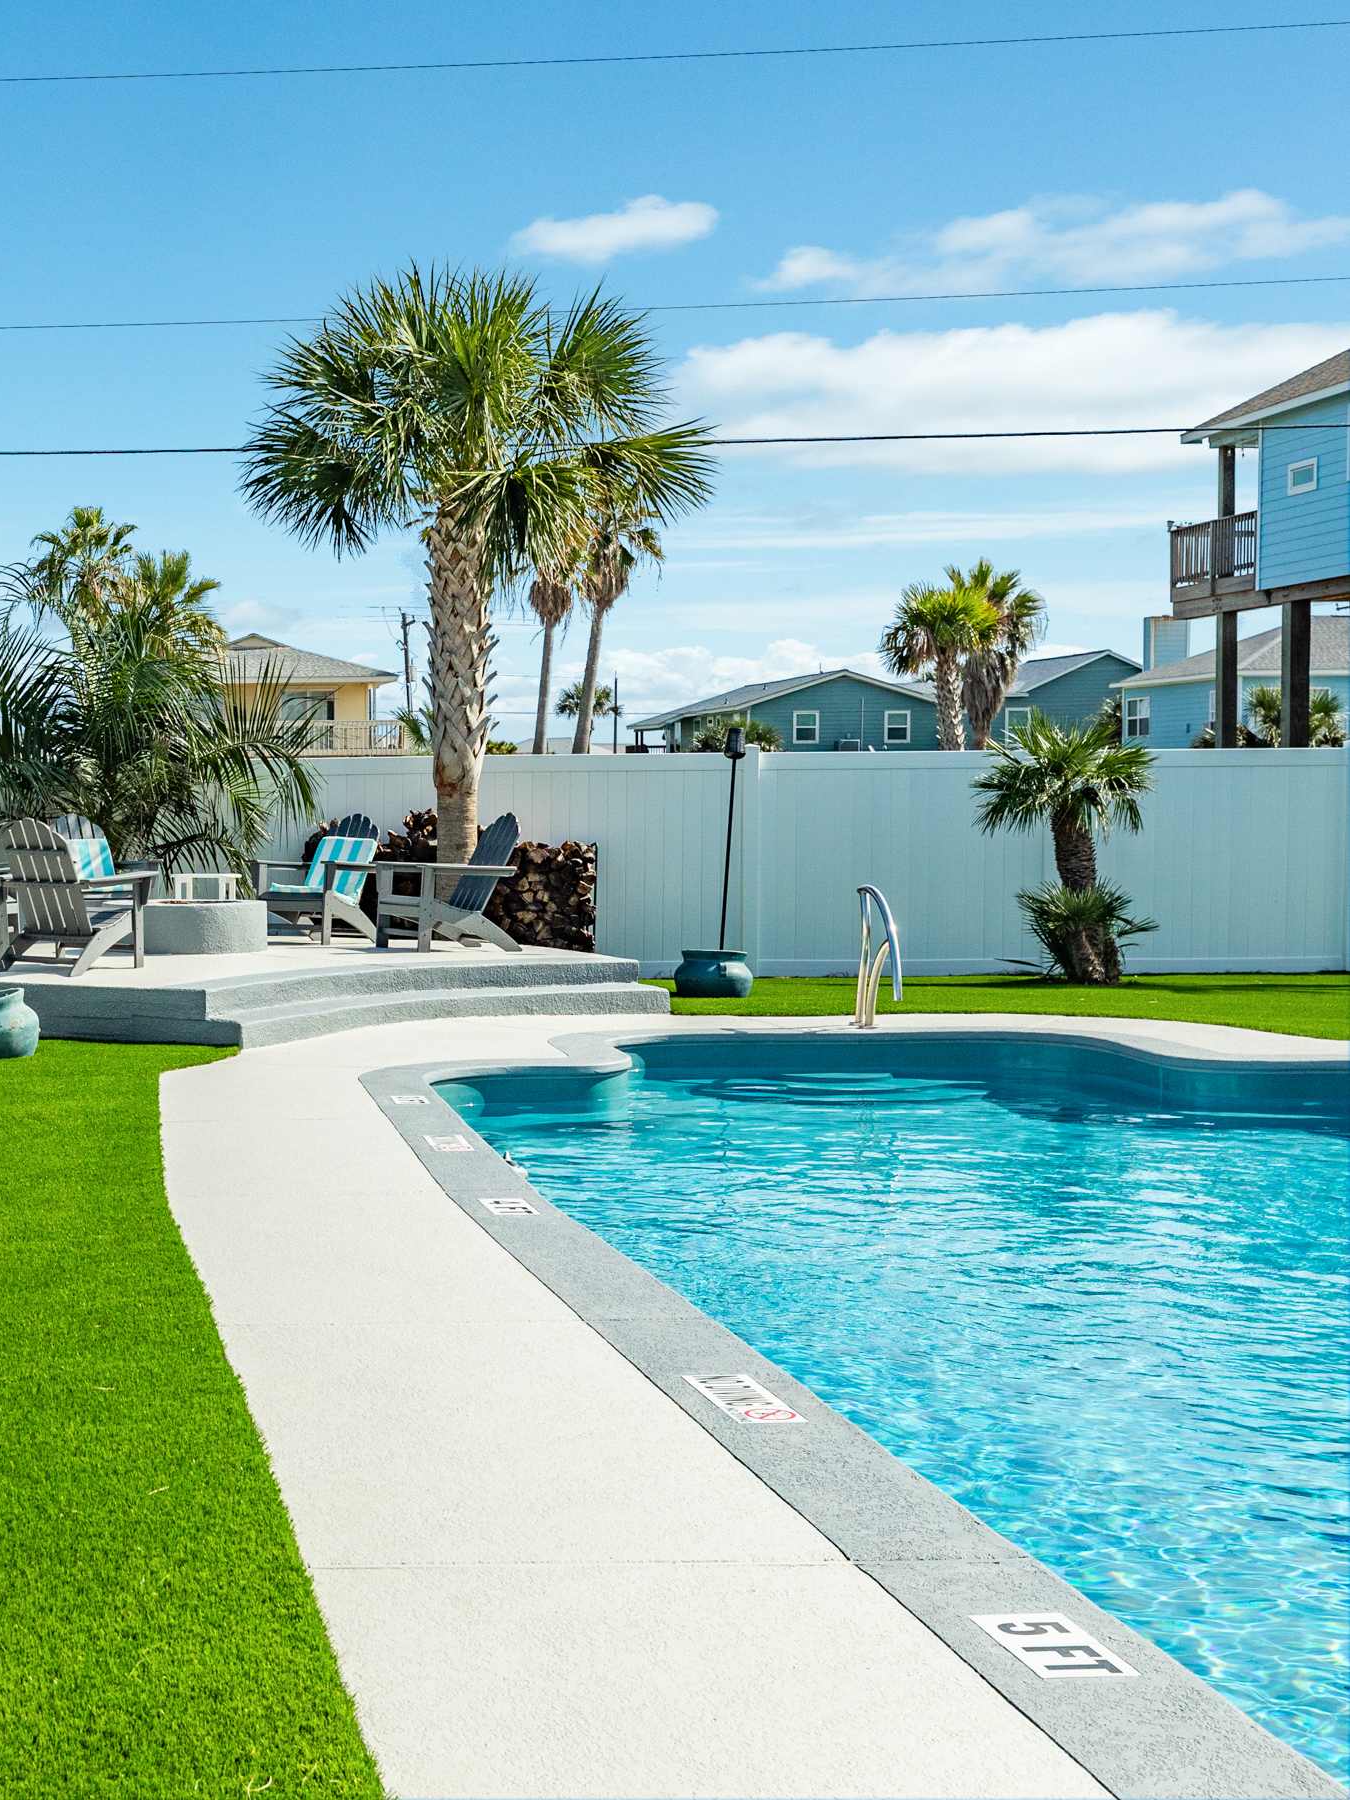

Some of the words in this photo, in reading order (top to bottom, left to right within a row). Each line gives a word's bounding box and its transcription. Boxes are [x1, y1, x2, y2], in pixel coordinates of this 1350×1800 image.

[494, 1206, 533, 1214] FT
[693, 1375, 745, 1384] NO
[705, 1385, 773, 1406] DIVING
[997, 1621, 1071, 1636] 5
[1022, 1645, 1124, 1674] FT
